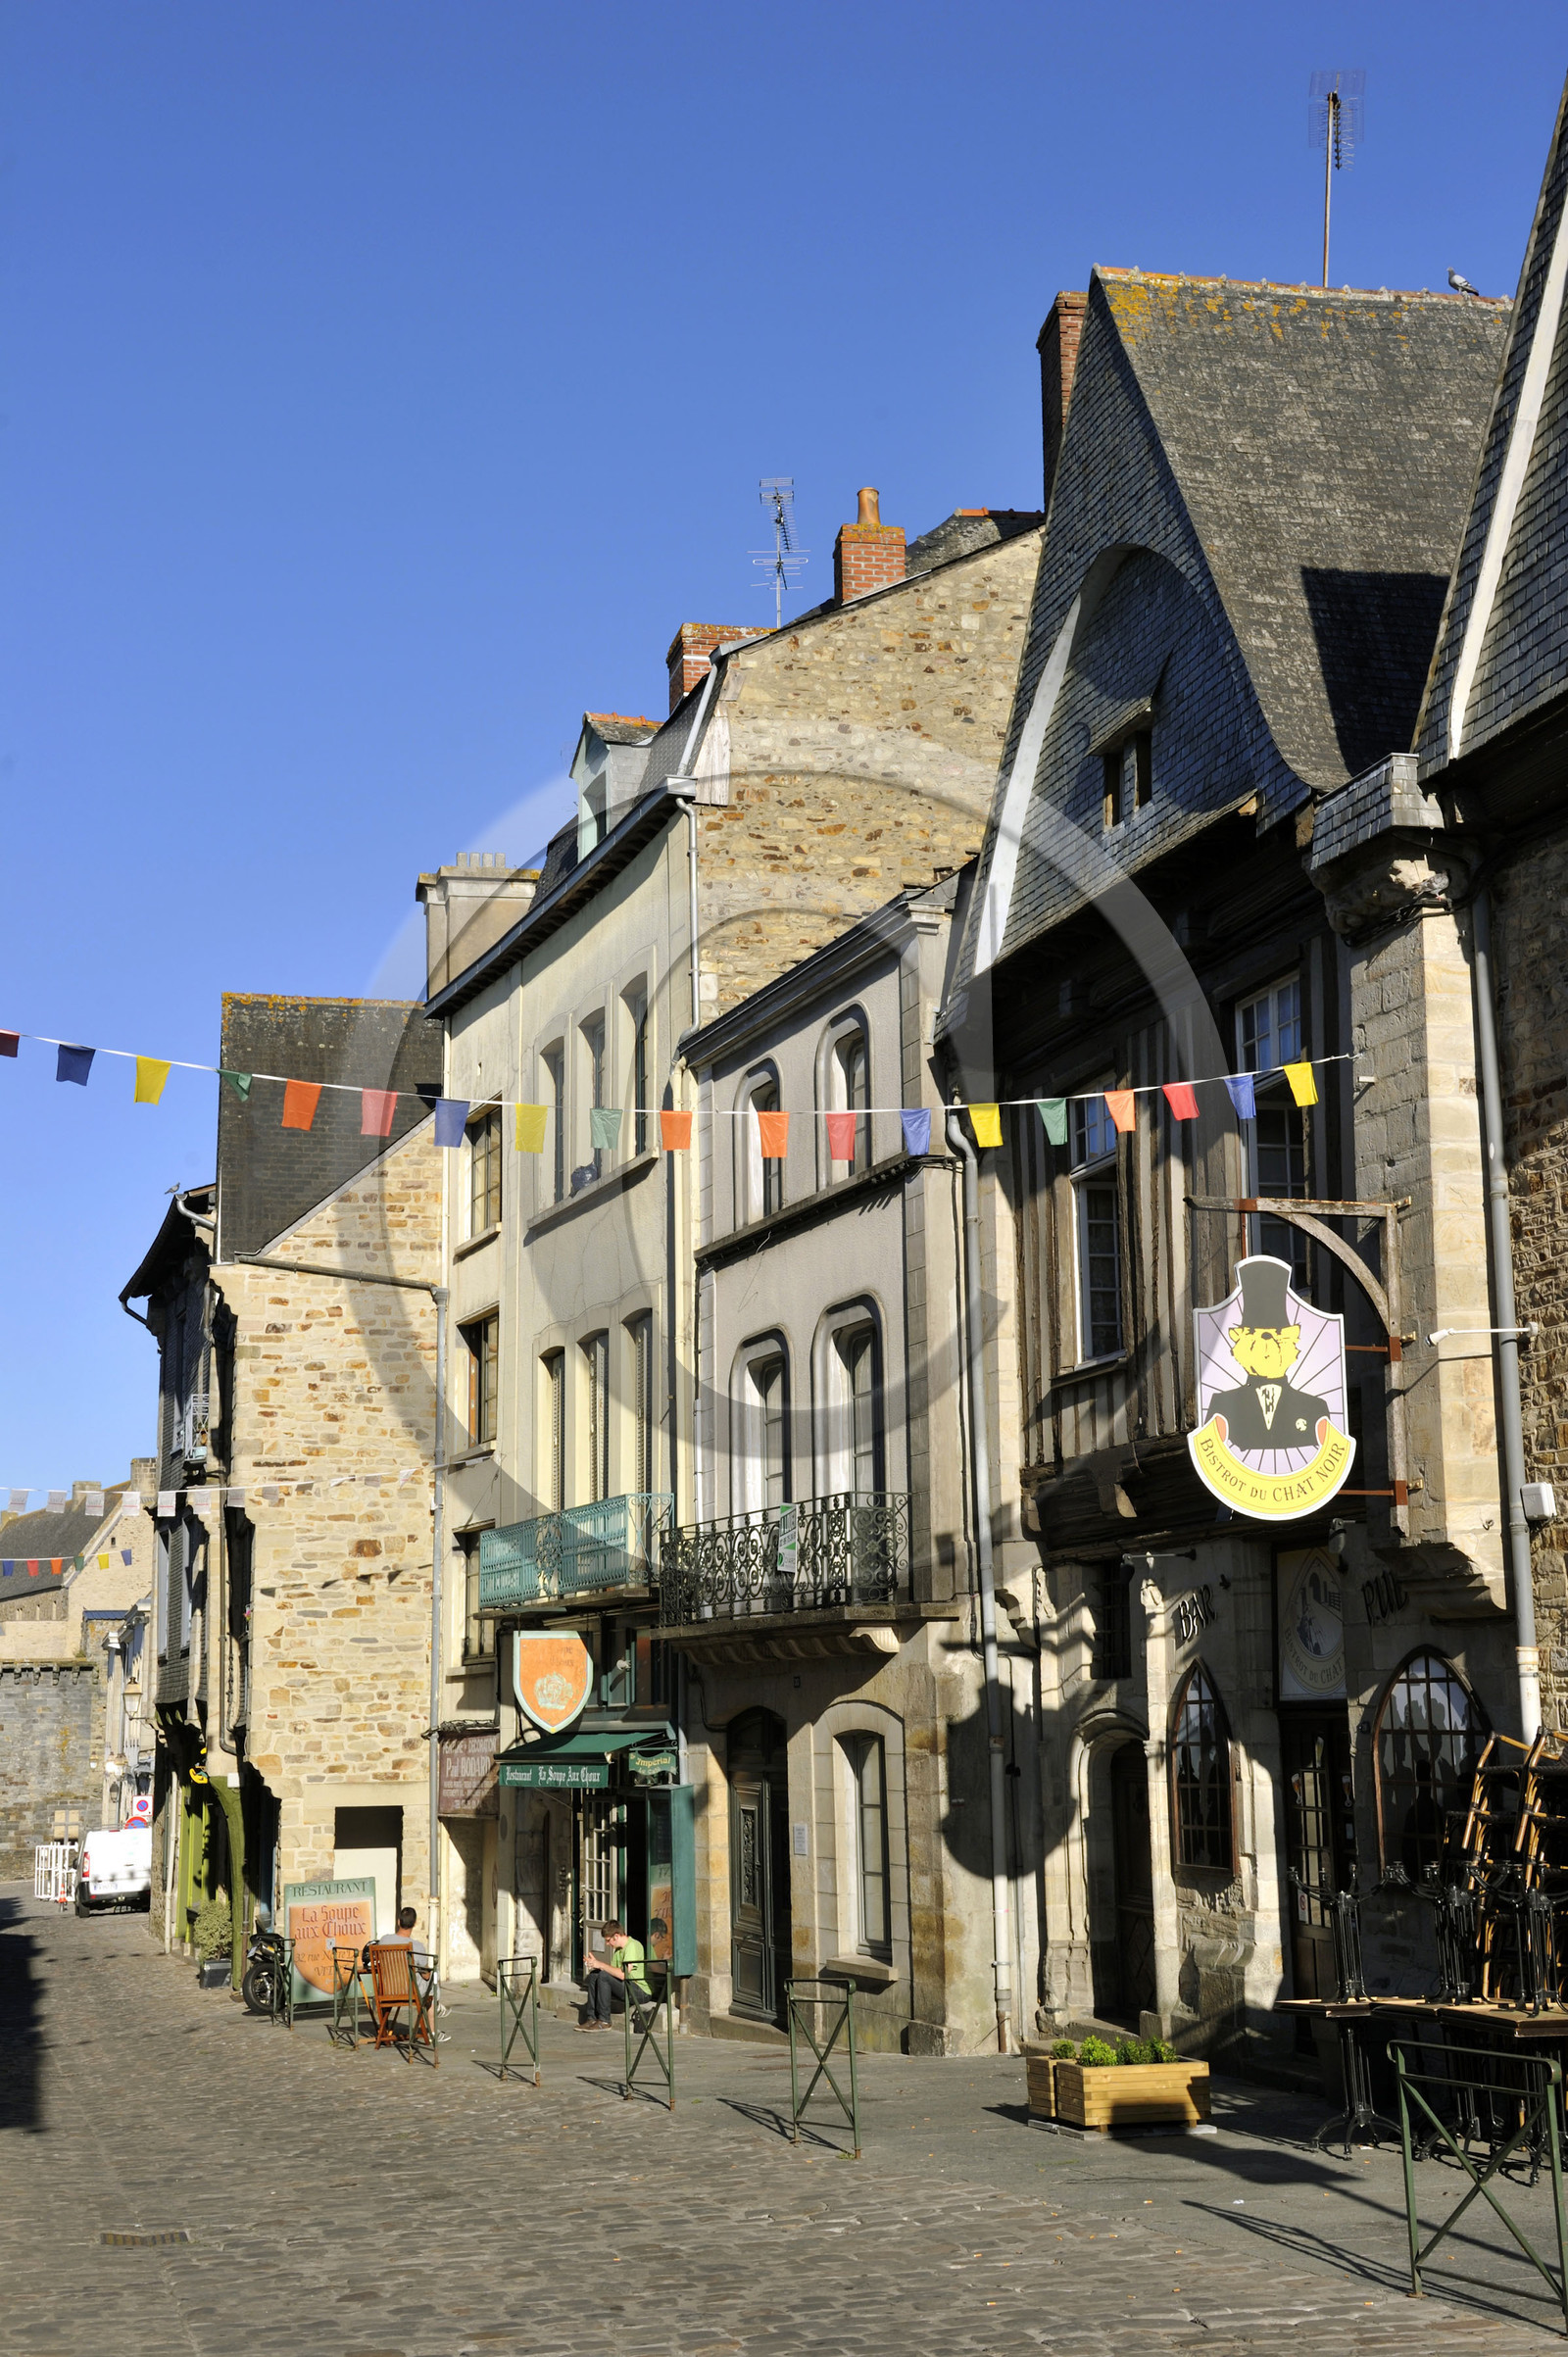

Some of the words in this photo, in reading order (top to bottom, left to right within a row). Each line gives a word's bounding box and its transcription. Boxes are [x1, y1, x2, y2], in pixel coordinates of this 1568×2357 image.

[1250, 1487, 1267, 1500] DU
[1272, 1476, 1315, 1502] CHAT
[1315, 1443, 1346, 1483] NOIR
[1178, 1584, 1216, 1642] BAR
[1321, 1657, 1343, 1684] CHAT
[446, 1756, 459, 1778] Paul
[461, 1755, 491, 1778] BODARD
[506, 1766, 532, 1786] Restaurant
[547, 1766, 566, 1786] Soupe
[566, 1766, 580, 1787] Aux
[580, 1766, 600, 1788] Choux
[293, 1882, 368, 1897] RESTAURANT
[302, 1907, 318, 1923] La
[321, 1905, 359, 1923] Soupe
[294, 1926, 319, 1940] aux
[322, 1920, 367, 1939] Choux
